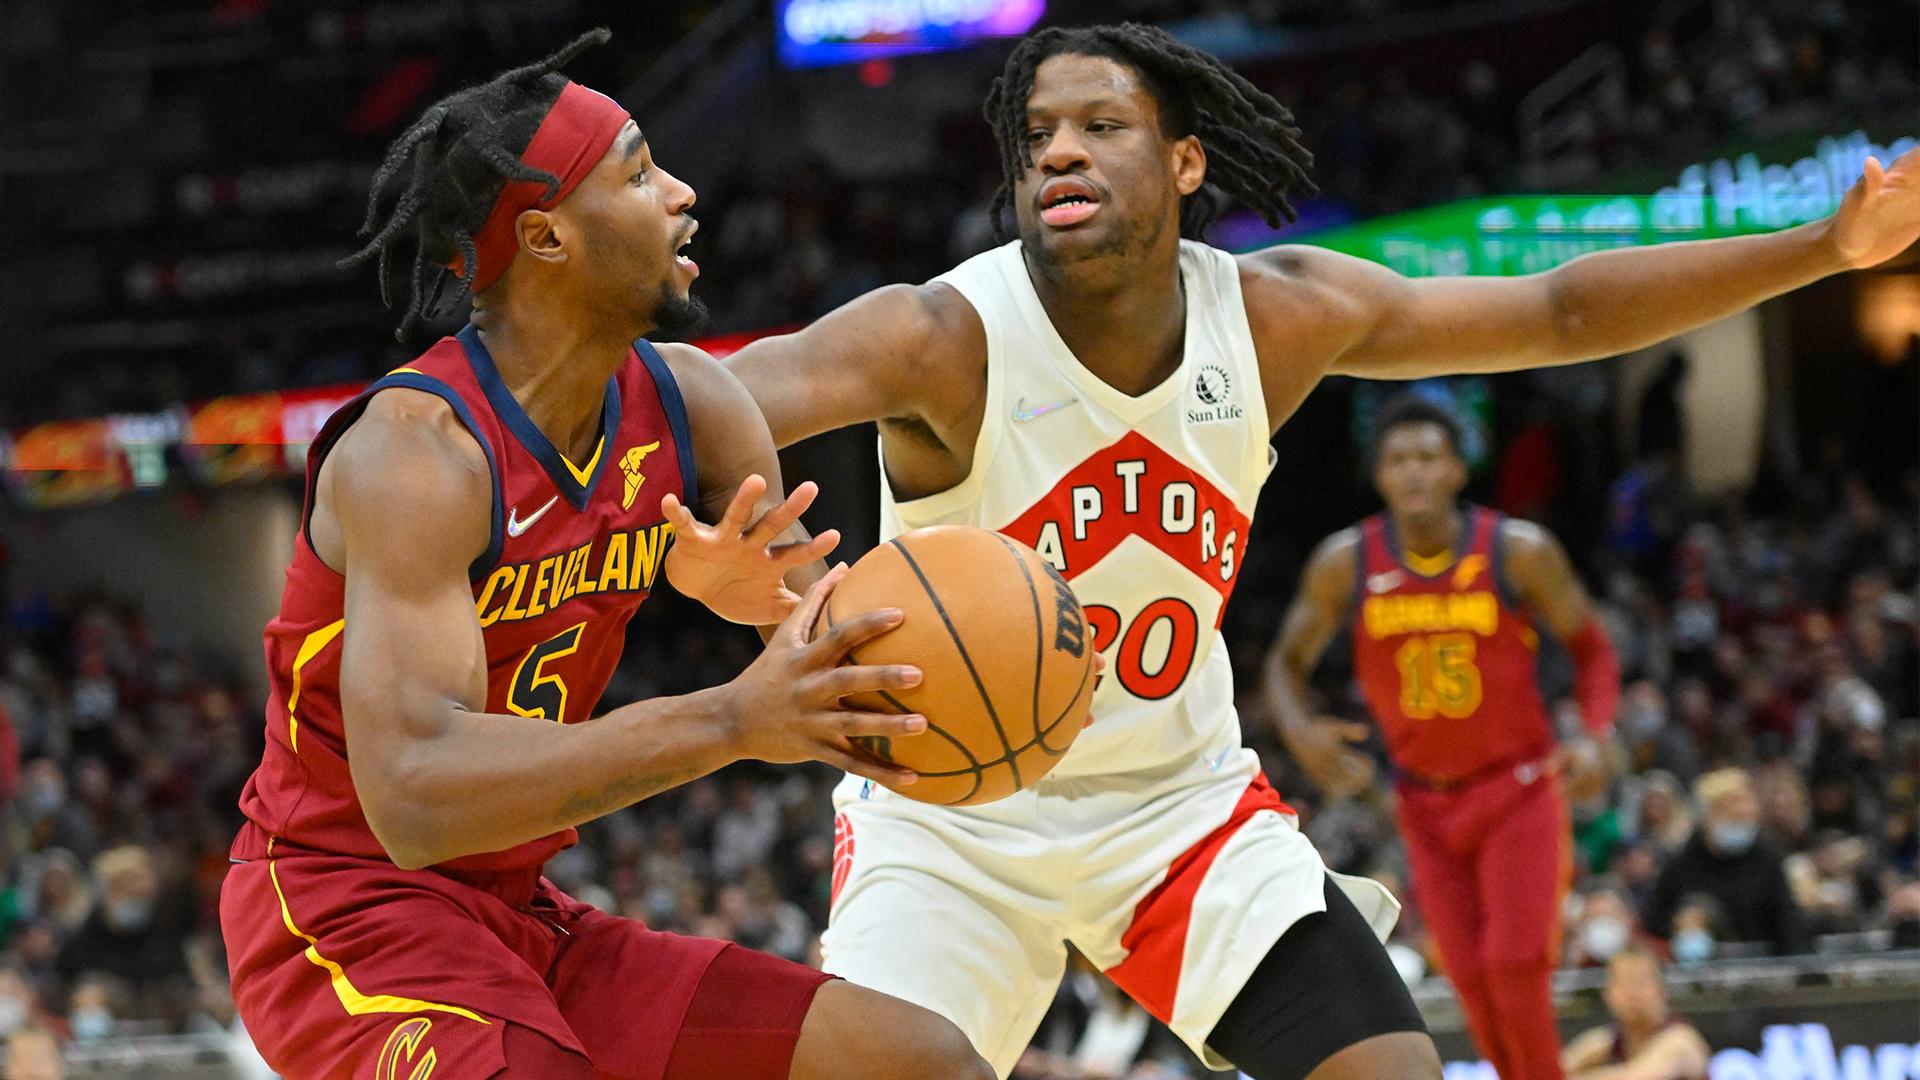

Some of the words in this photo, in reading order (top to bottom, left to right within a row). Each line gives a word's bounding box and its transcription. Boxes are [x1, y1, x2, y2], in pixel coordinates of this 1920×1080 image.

[1187, 409, 1214, 424] Sun
[1217, 404, 1243, 420] Life
[1034, 458, 1238, 583] APTORS
[506, 621, 588, 724] 5
[1395, 632, 1483, 720] 15
